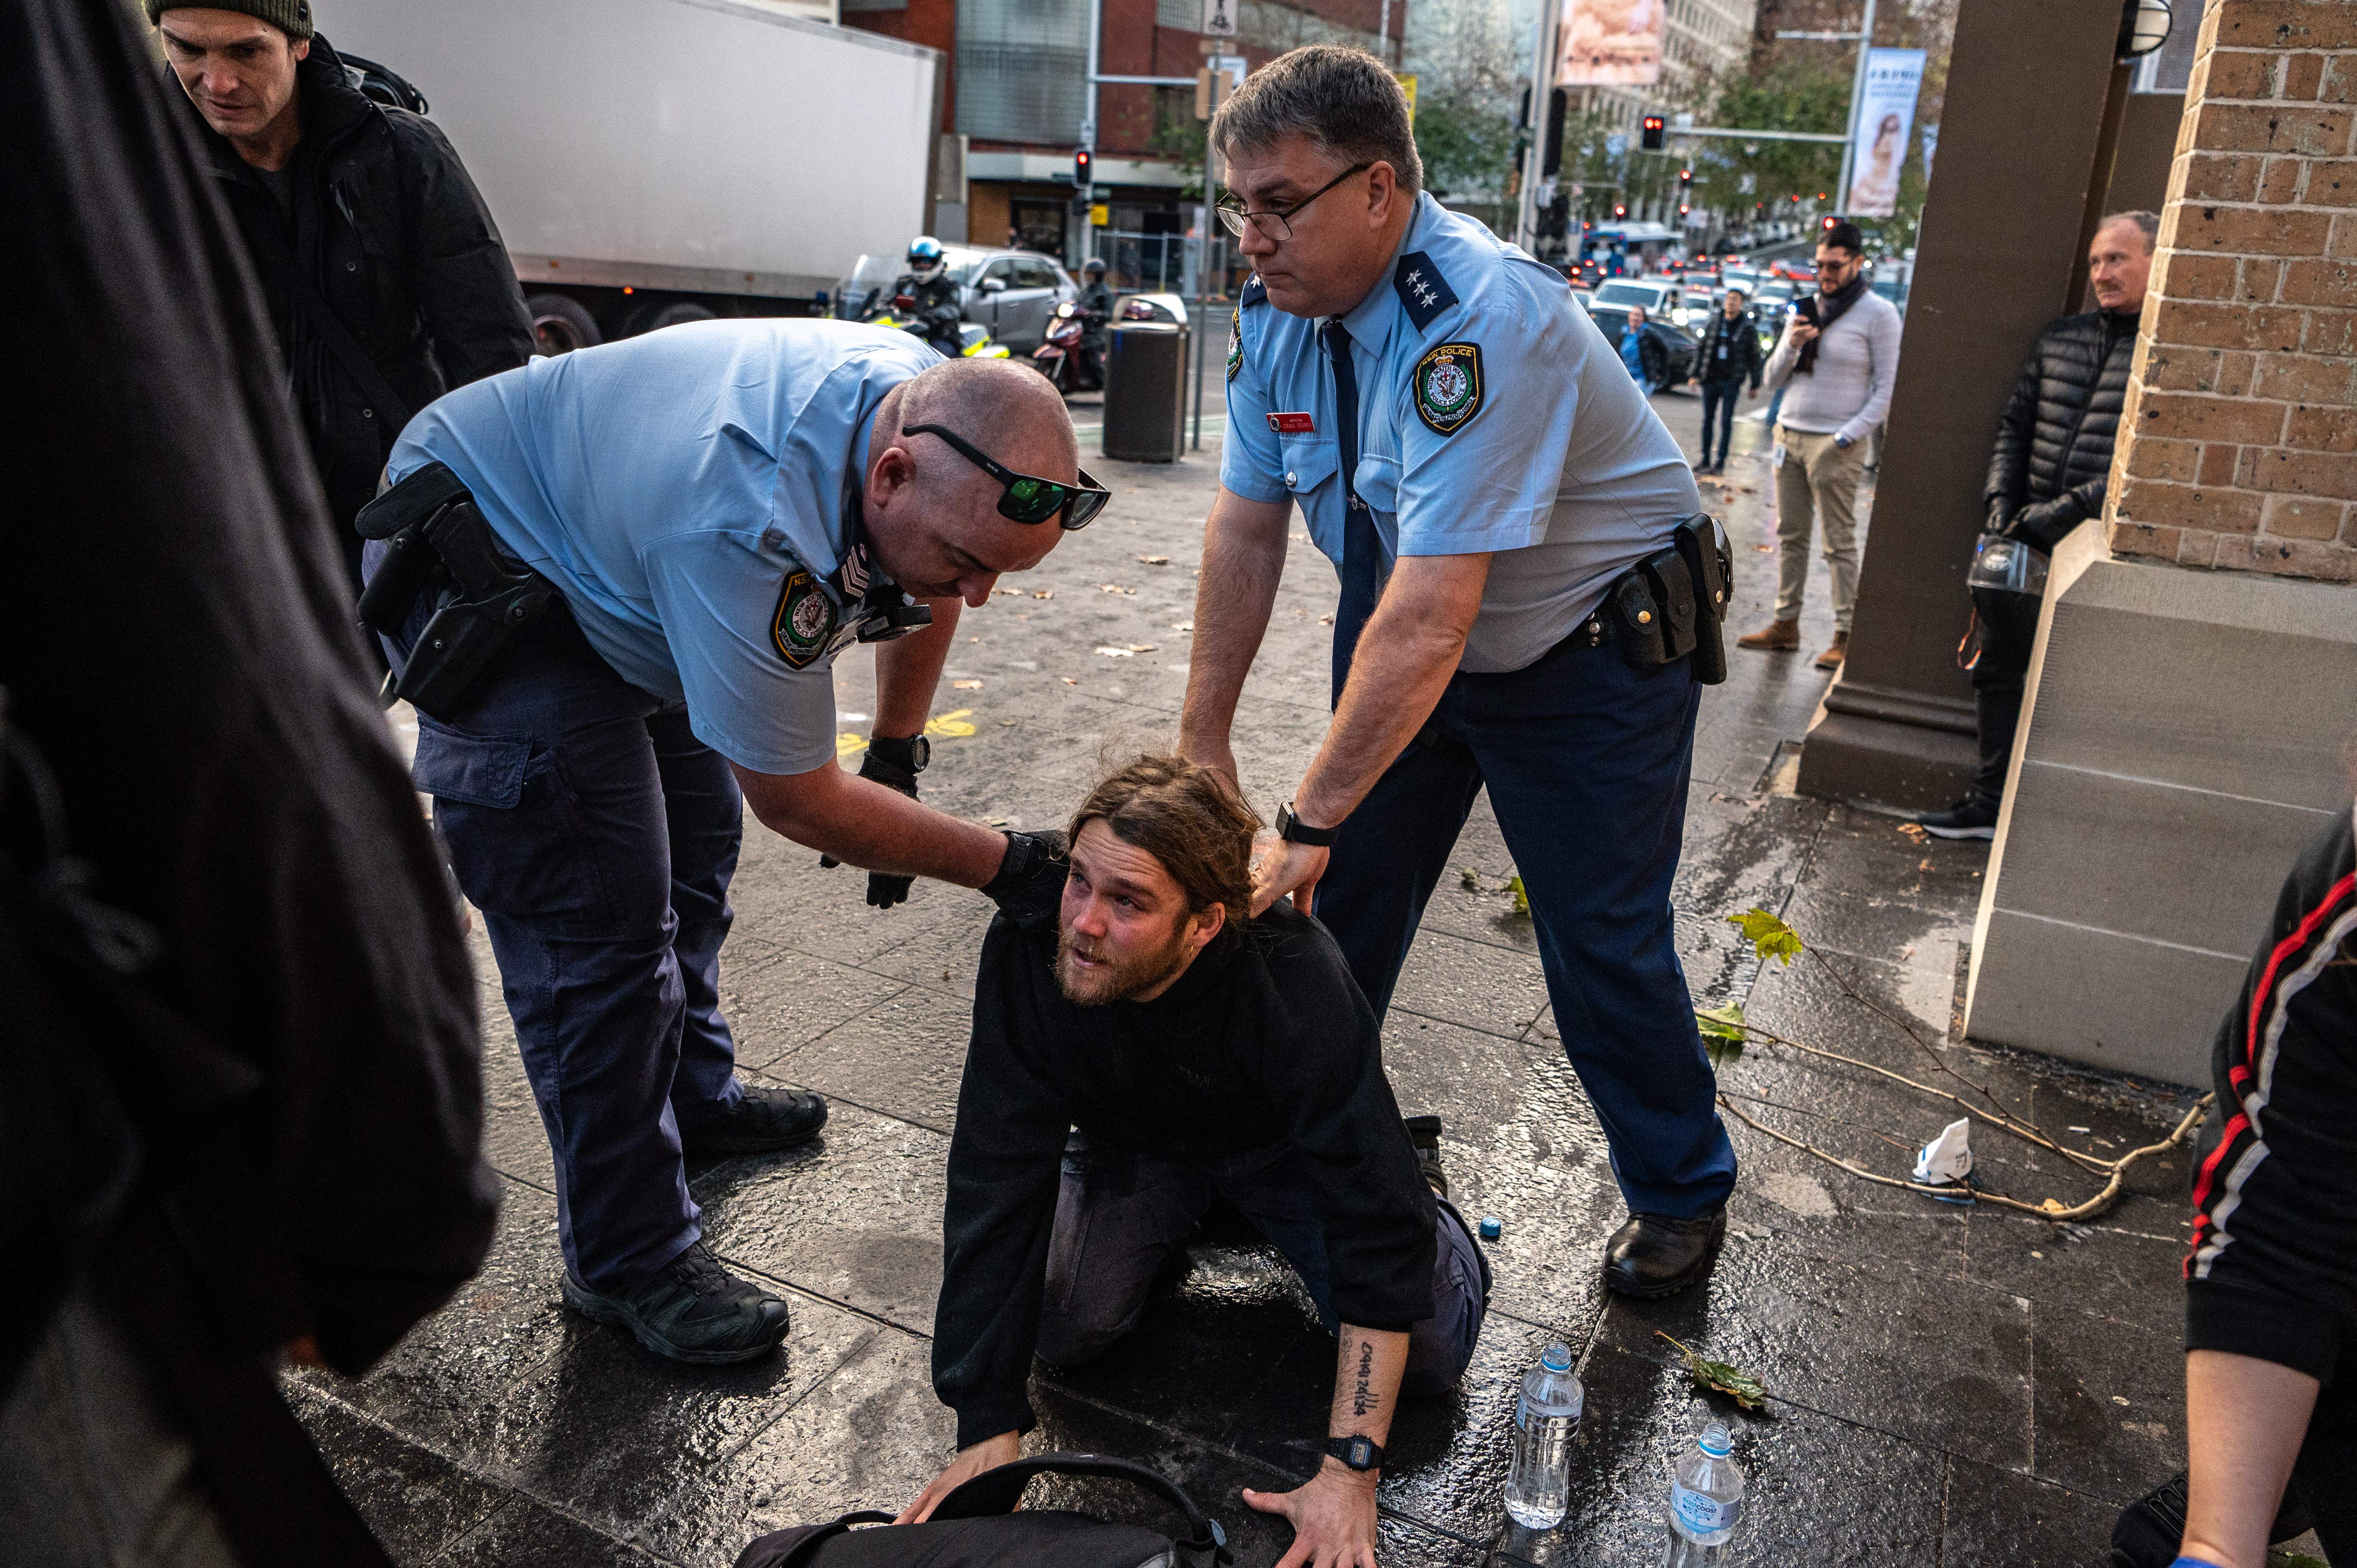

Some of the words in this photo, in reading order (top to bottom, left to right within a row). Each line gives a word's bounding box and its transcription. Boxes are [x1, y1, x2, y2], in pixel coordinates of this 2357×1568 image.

[1441, 348, 1472, 357] POLICE
[1434, 365, 1452, 376] SOUTH
[1453, 367, 1466, 386] WALES
[1430, 392, 1447, 405] POLICE
[1448, 388, 1465, 405] FORCE
[794, 601, 805, 616] NEW
[806, 594, 822, 603] SOUTH
[794, 620, 809, 637] POLICE
[1682, 1496, 1717, 1514] eastcoast
